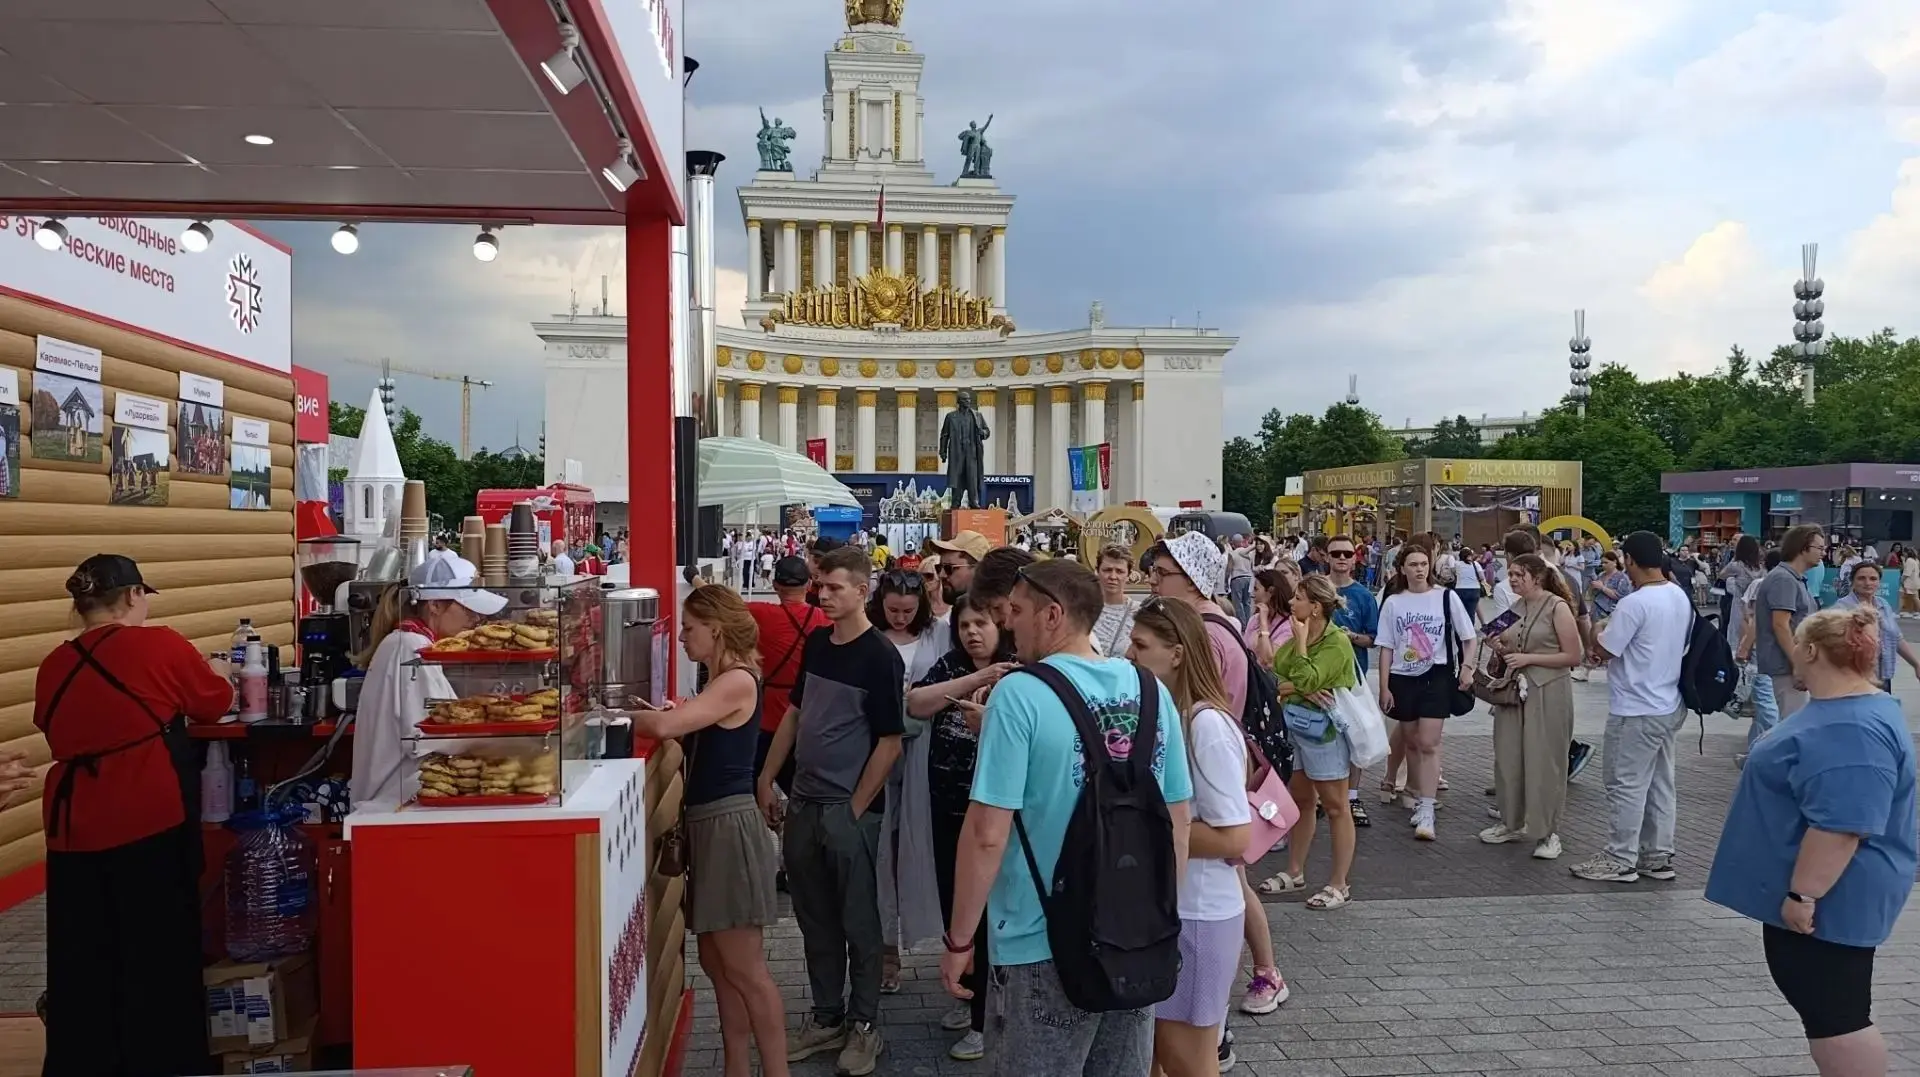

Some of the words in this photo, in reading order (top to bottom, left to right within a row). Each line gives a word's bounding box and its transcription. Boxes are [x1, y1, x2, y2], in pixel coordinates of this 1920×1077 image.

[15, 216, 126, 274] этческие
[130, 259, 175, 293] места
[39, 351, 99, 373] Карамас-Пельга
[1467, 462, 1557, 477] ЯРОСЛАВИЯ
[1420, 621, 1444, 637] Treat
